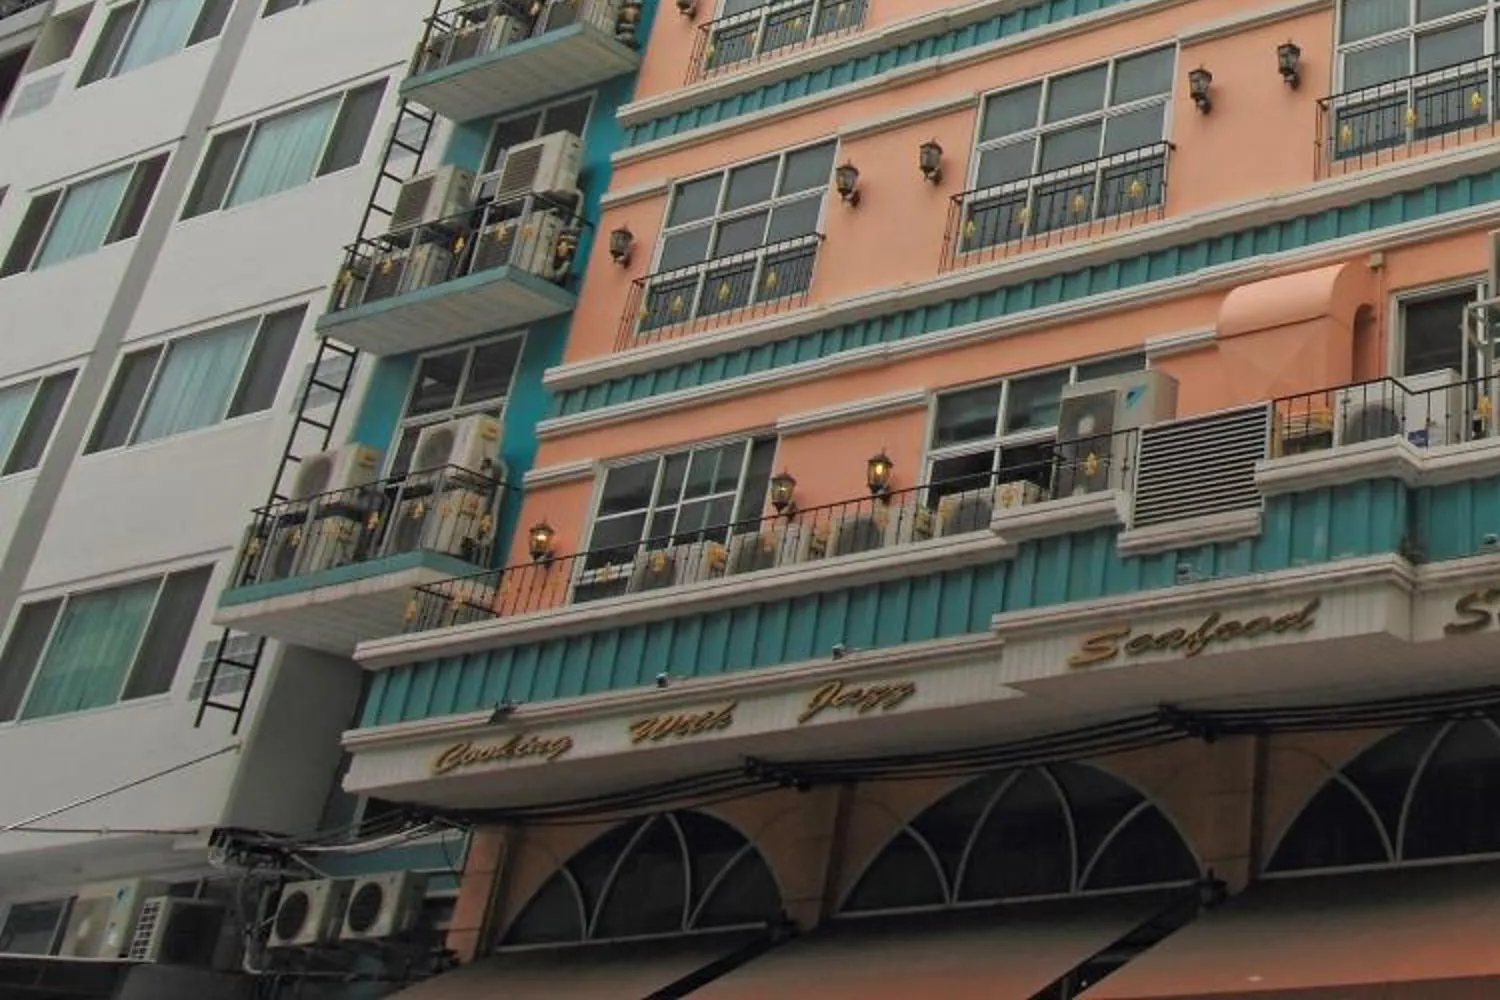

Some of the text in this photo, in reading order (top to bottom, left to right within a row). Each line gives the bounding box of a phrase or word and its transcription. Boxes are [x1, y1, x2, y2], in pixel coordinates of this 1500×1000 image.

[431, 731, 574, 775] Cooking
[628, 701, 738, 745] With
[797, 679, 918, 724] Jazz
[1067, 596, 1323, 668] Seafood
